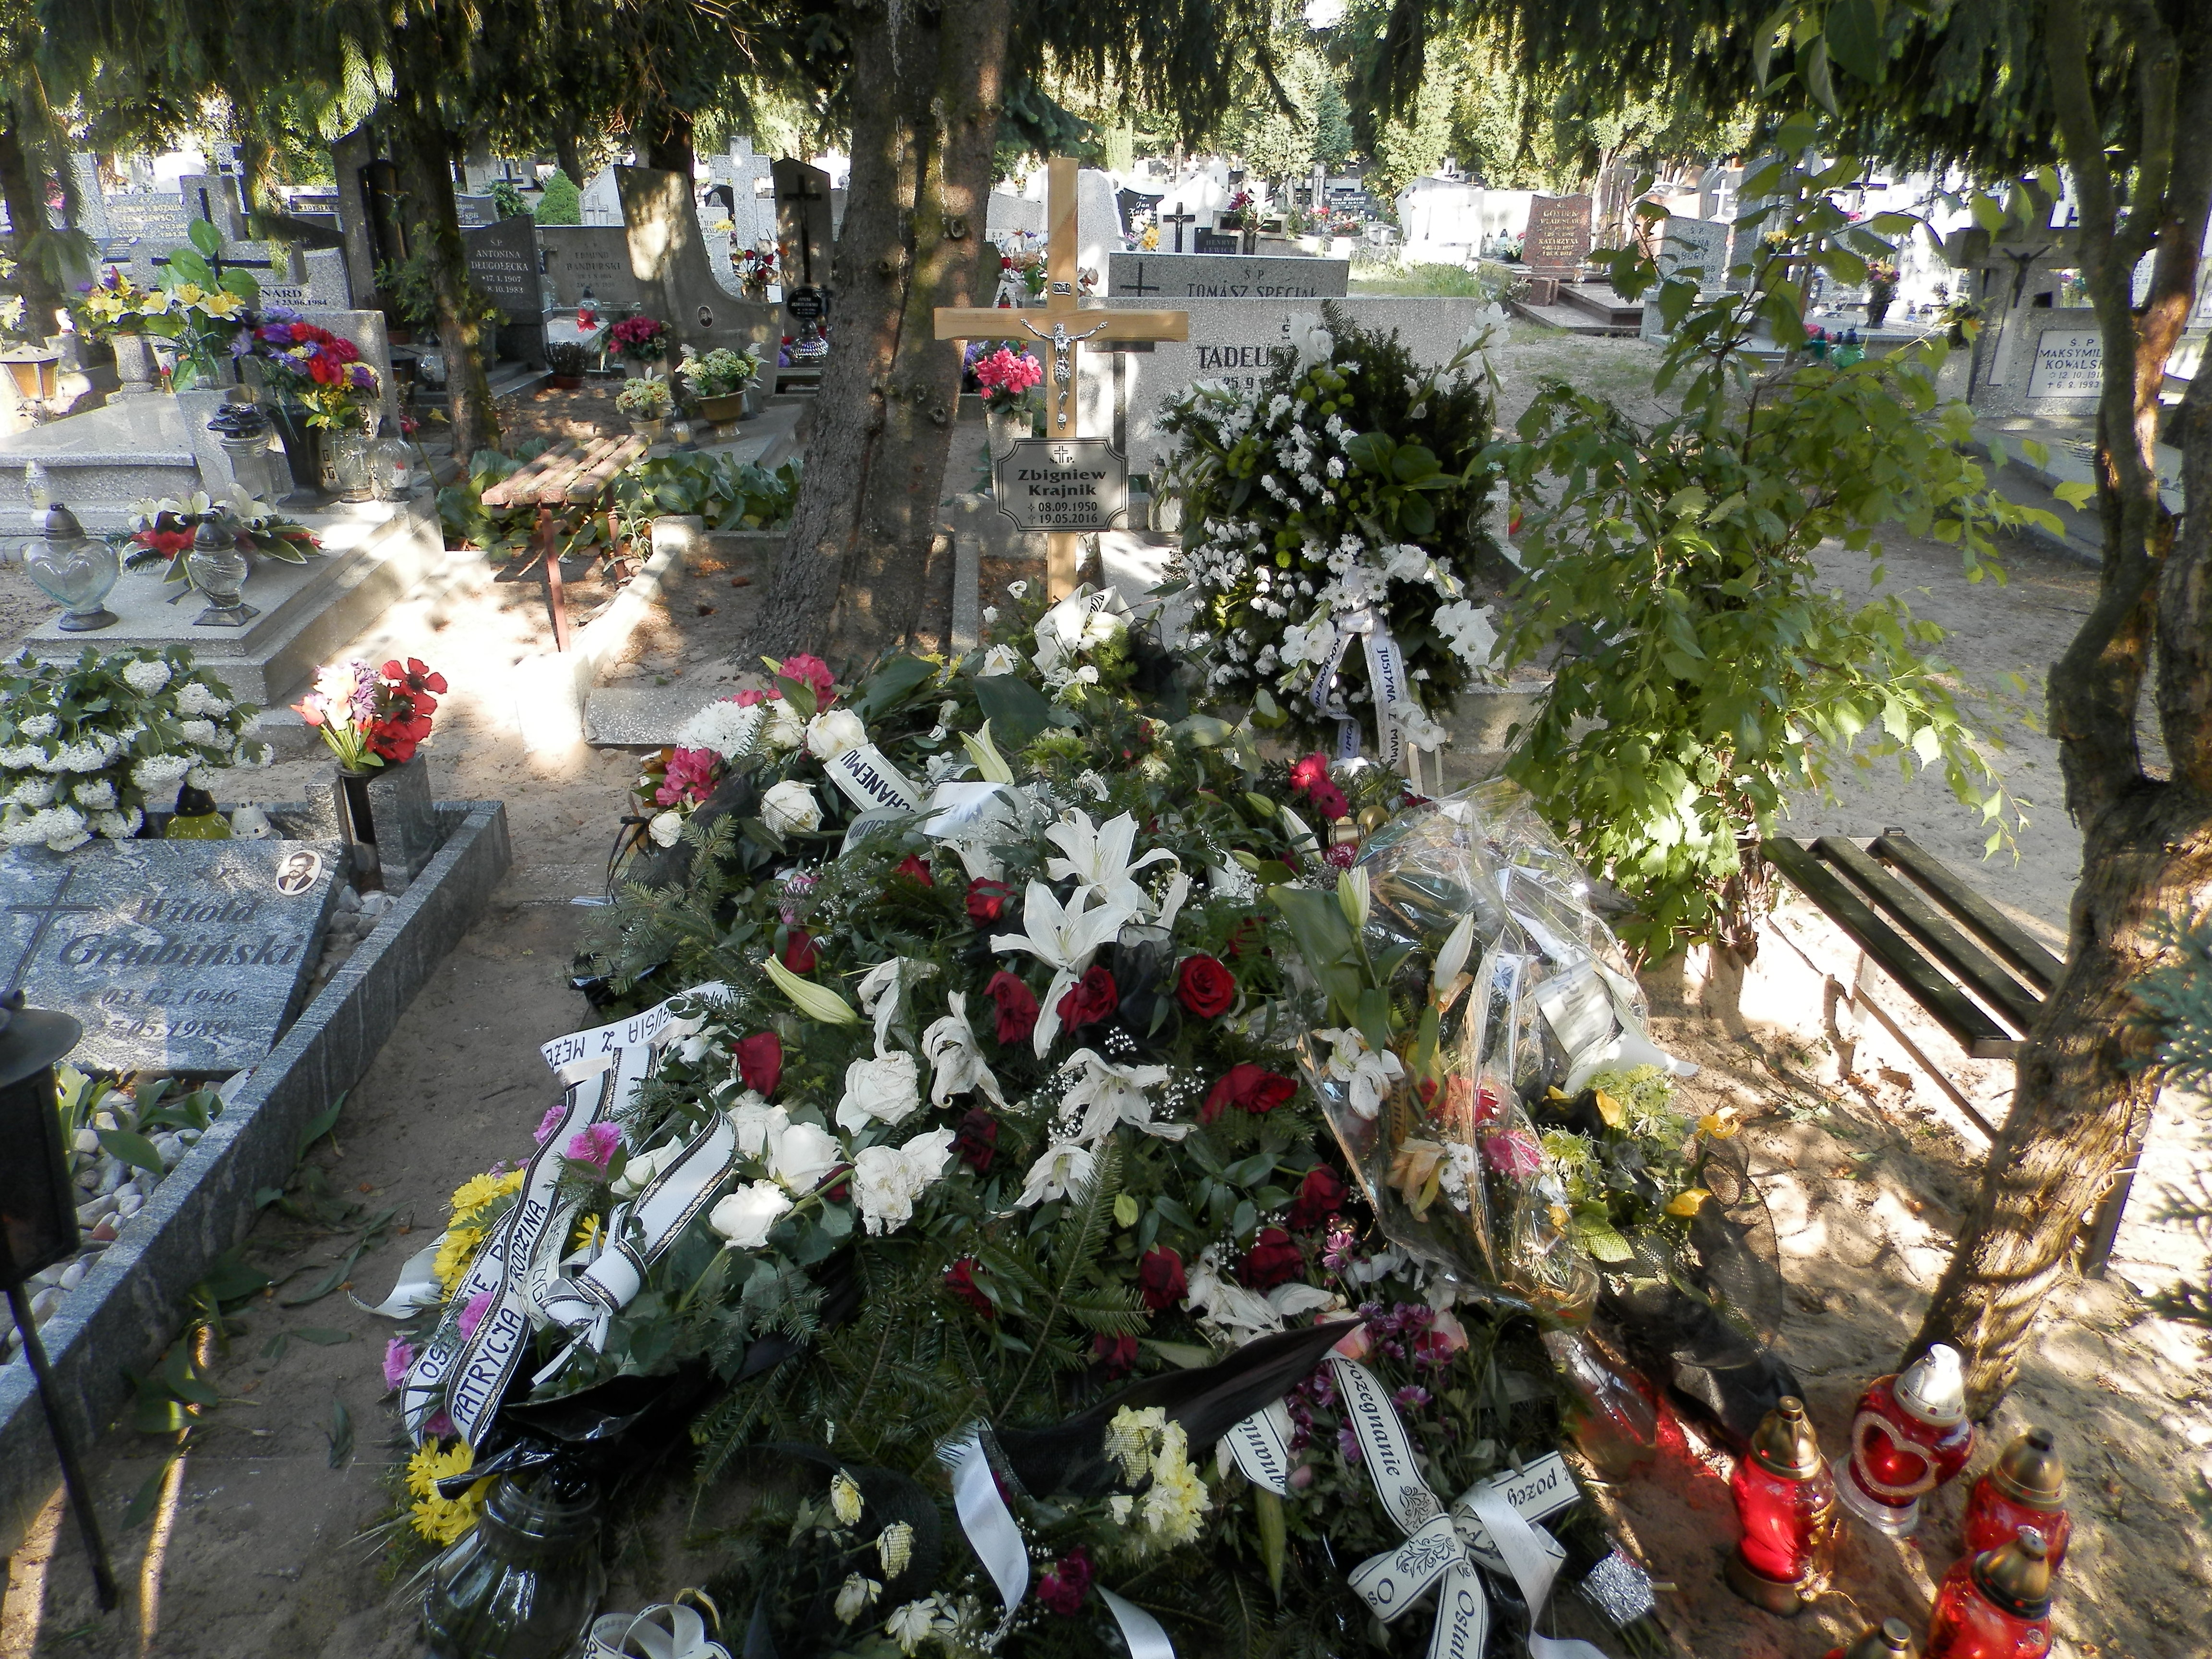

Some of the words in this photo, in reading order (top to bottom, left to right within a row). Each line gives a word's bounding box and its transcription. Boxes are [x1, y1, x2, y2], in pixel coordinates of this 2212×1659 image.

[476, 250, 521, 258] ANTONINA
[471, 261, 528, 273] DŁUGOŁĘCKA
[1196, 345, 1269, 369] TADEU
[2039, 349, 2103, 358] MAKSYMIL
[1018, 469, 1106, 483] Zbigniew
[1029, 484, 1096, 498] Krajnik
[1038, 502, 1097, 512] 08.09.1950
[1040, 514, 1098, 524] 19.05.2016
[1376, 647, 1396, 704] JUSTYNA
[60, 933, 306, 966] Grubiński
[454, 1308, 521, 1425] PATRYCJA
[1449, 1589, 1475, 1659] Ostat
